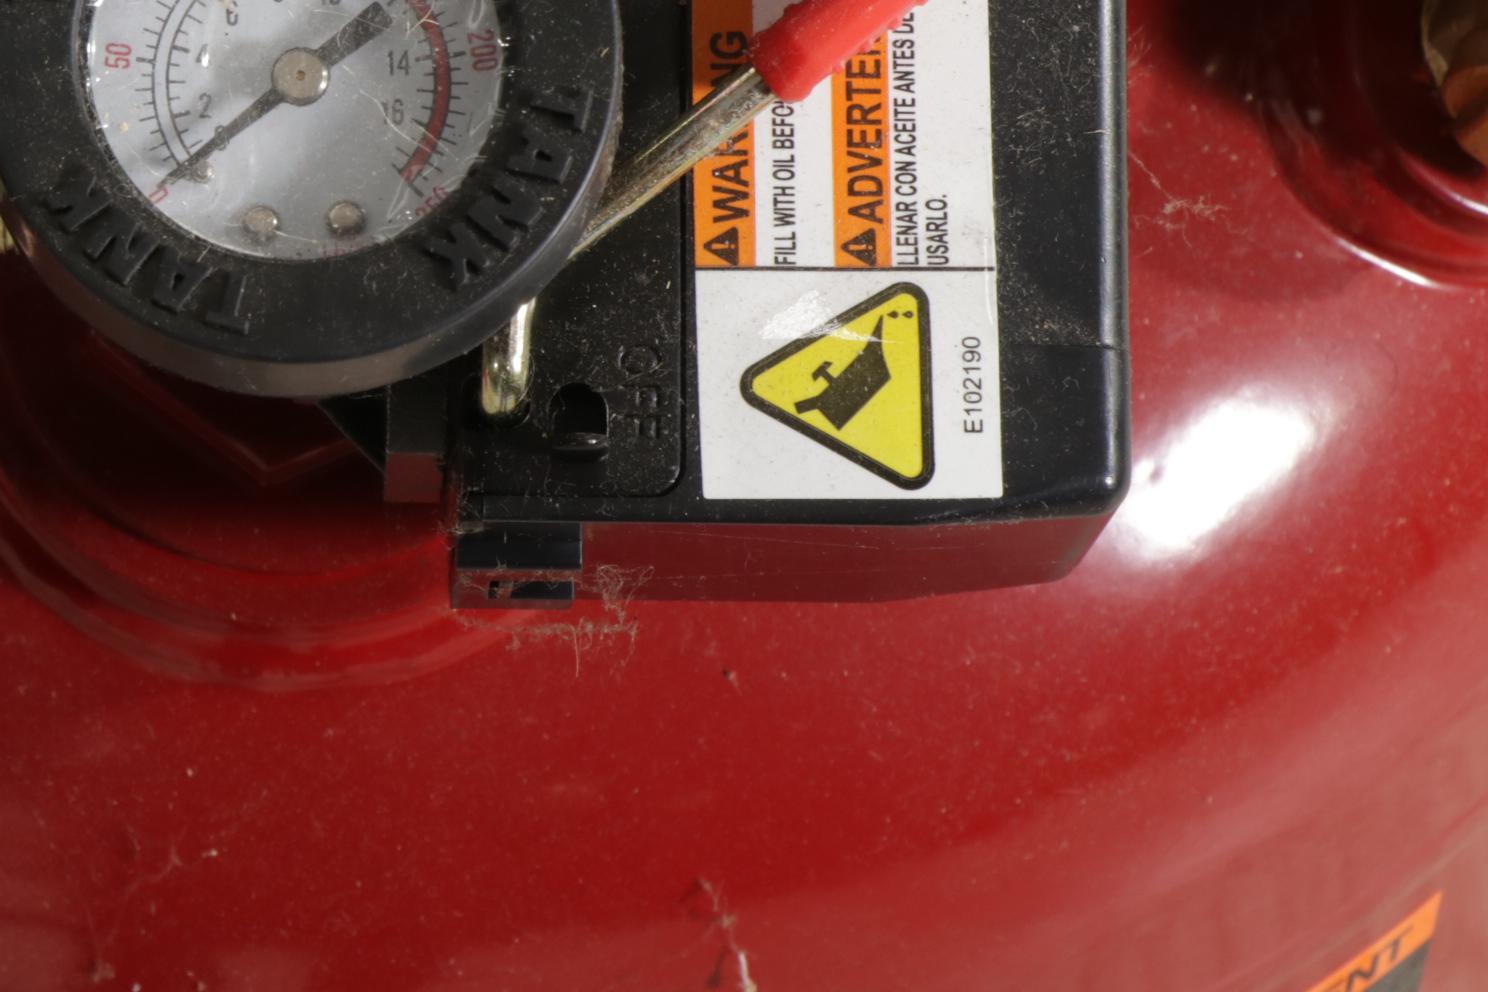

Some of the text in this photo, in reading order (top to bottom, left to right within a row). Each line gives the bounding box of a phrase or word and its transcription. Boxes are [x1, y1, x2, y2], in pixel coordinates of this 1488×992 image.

[104, 42, 132, 70] 50
[387, 50, 410, 76] 14
[467, 29, 498, 73] 200
[892, 38, 915, 94] ANTES
[199, 92, 212, 119] 2
[382, 98, 405, 125] 16
[710, 30, 750, 224] WARG
[845, 36, 883, 224] ADVERTE
[893, 97, 916, 157] ACEITE
[772, 154, 795, 181] OIL
[894, 161, 917, 196] CON
[773, 186, 796, 227] WITH
[774, 231, 796, 265] FILL
[896, 200, 919, 266] LLENAR
[925, 194, 949, 266] USARLO.
[961, 336, 983, 434] E102190
